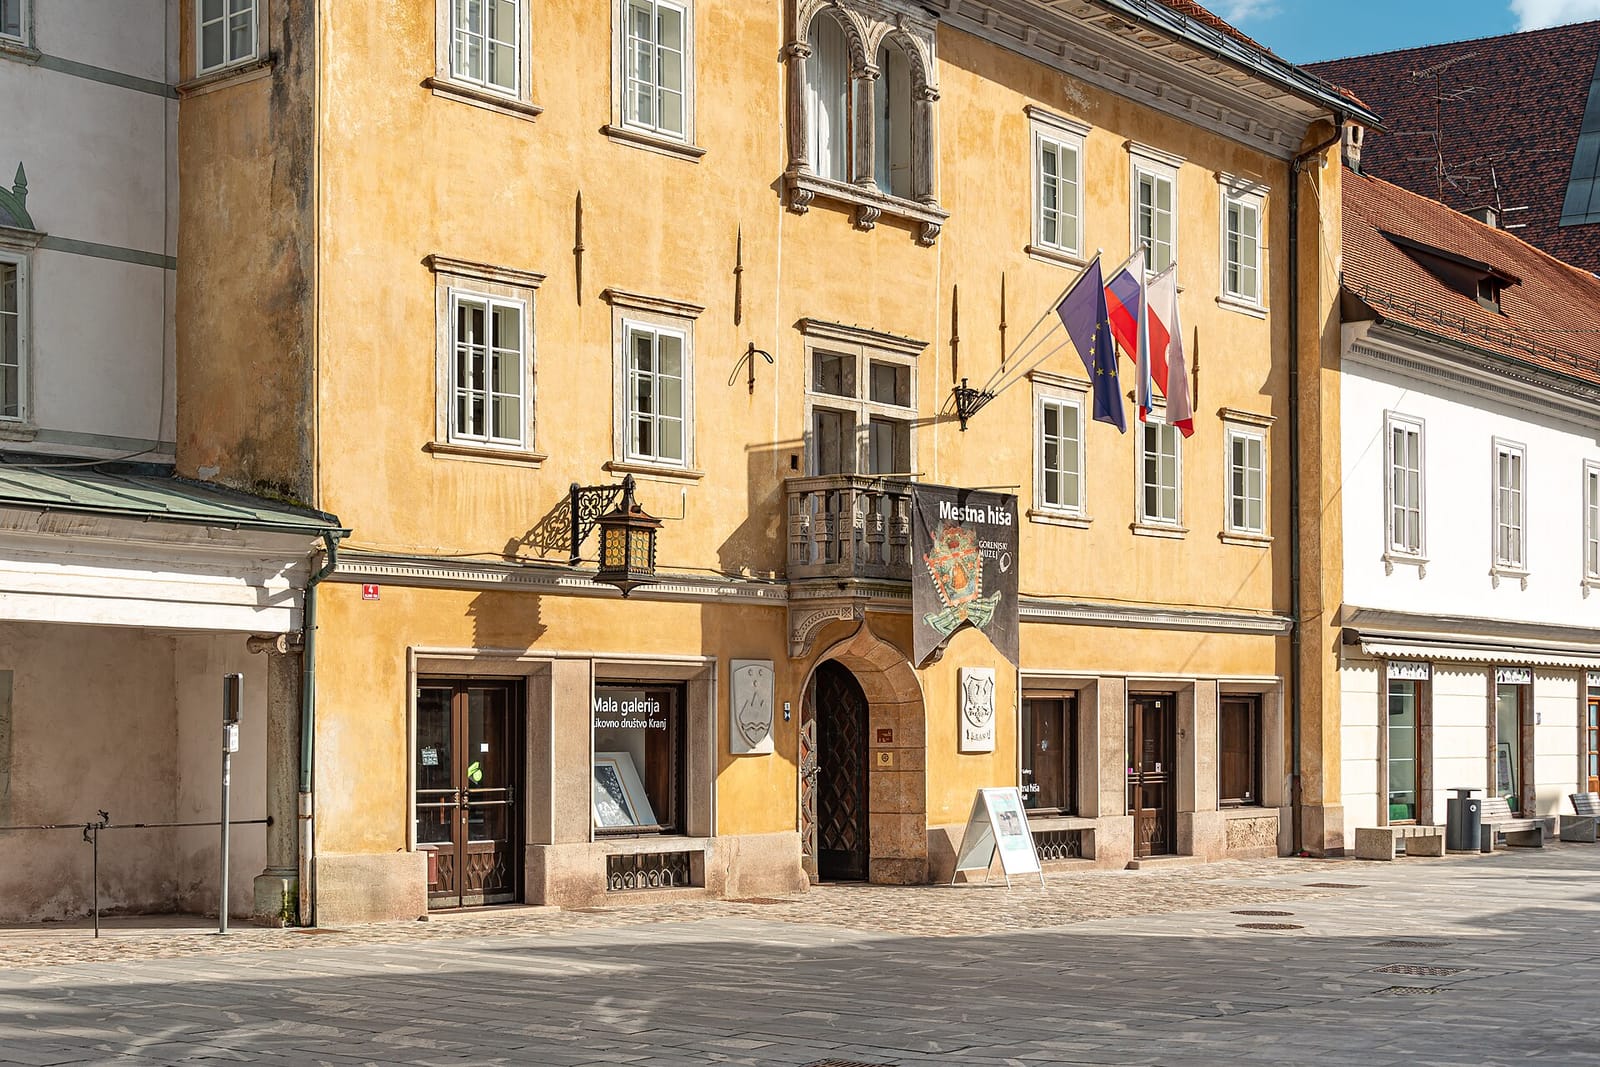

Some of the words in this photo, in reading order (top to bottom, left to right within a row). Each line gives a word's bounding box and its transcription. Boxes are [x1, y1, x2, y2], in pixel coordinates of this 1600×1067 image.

[940, 501, 985, 523] Mestna
[987, 505, 1012, 526] hiša
[593, 697, 618, 712] Mala
[621, 697, 660, 717] galerija
[620, 718, 648, 728] društvo
[648, 718, 667, 731] Kranj
